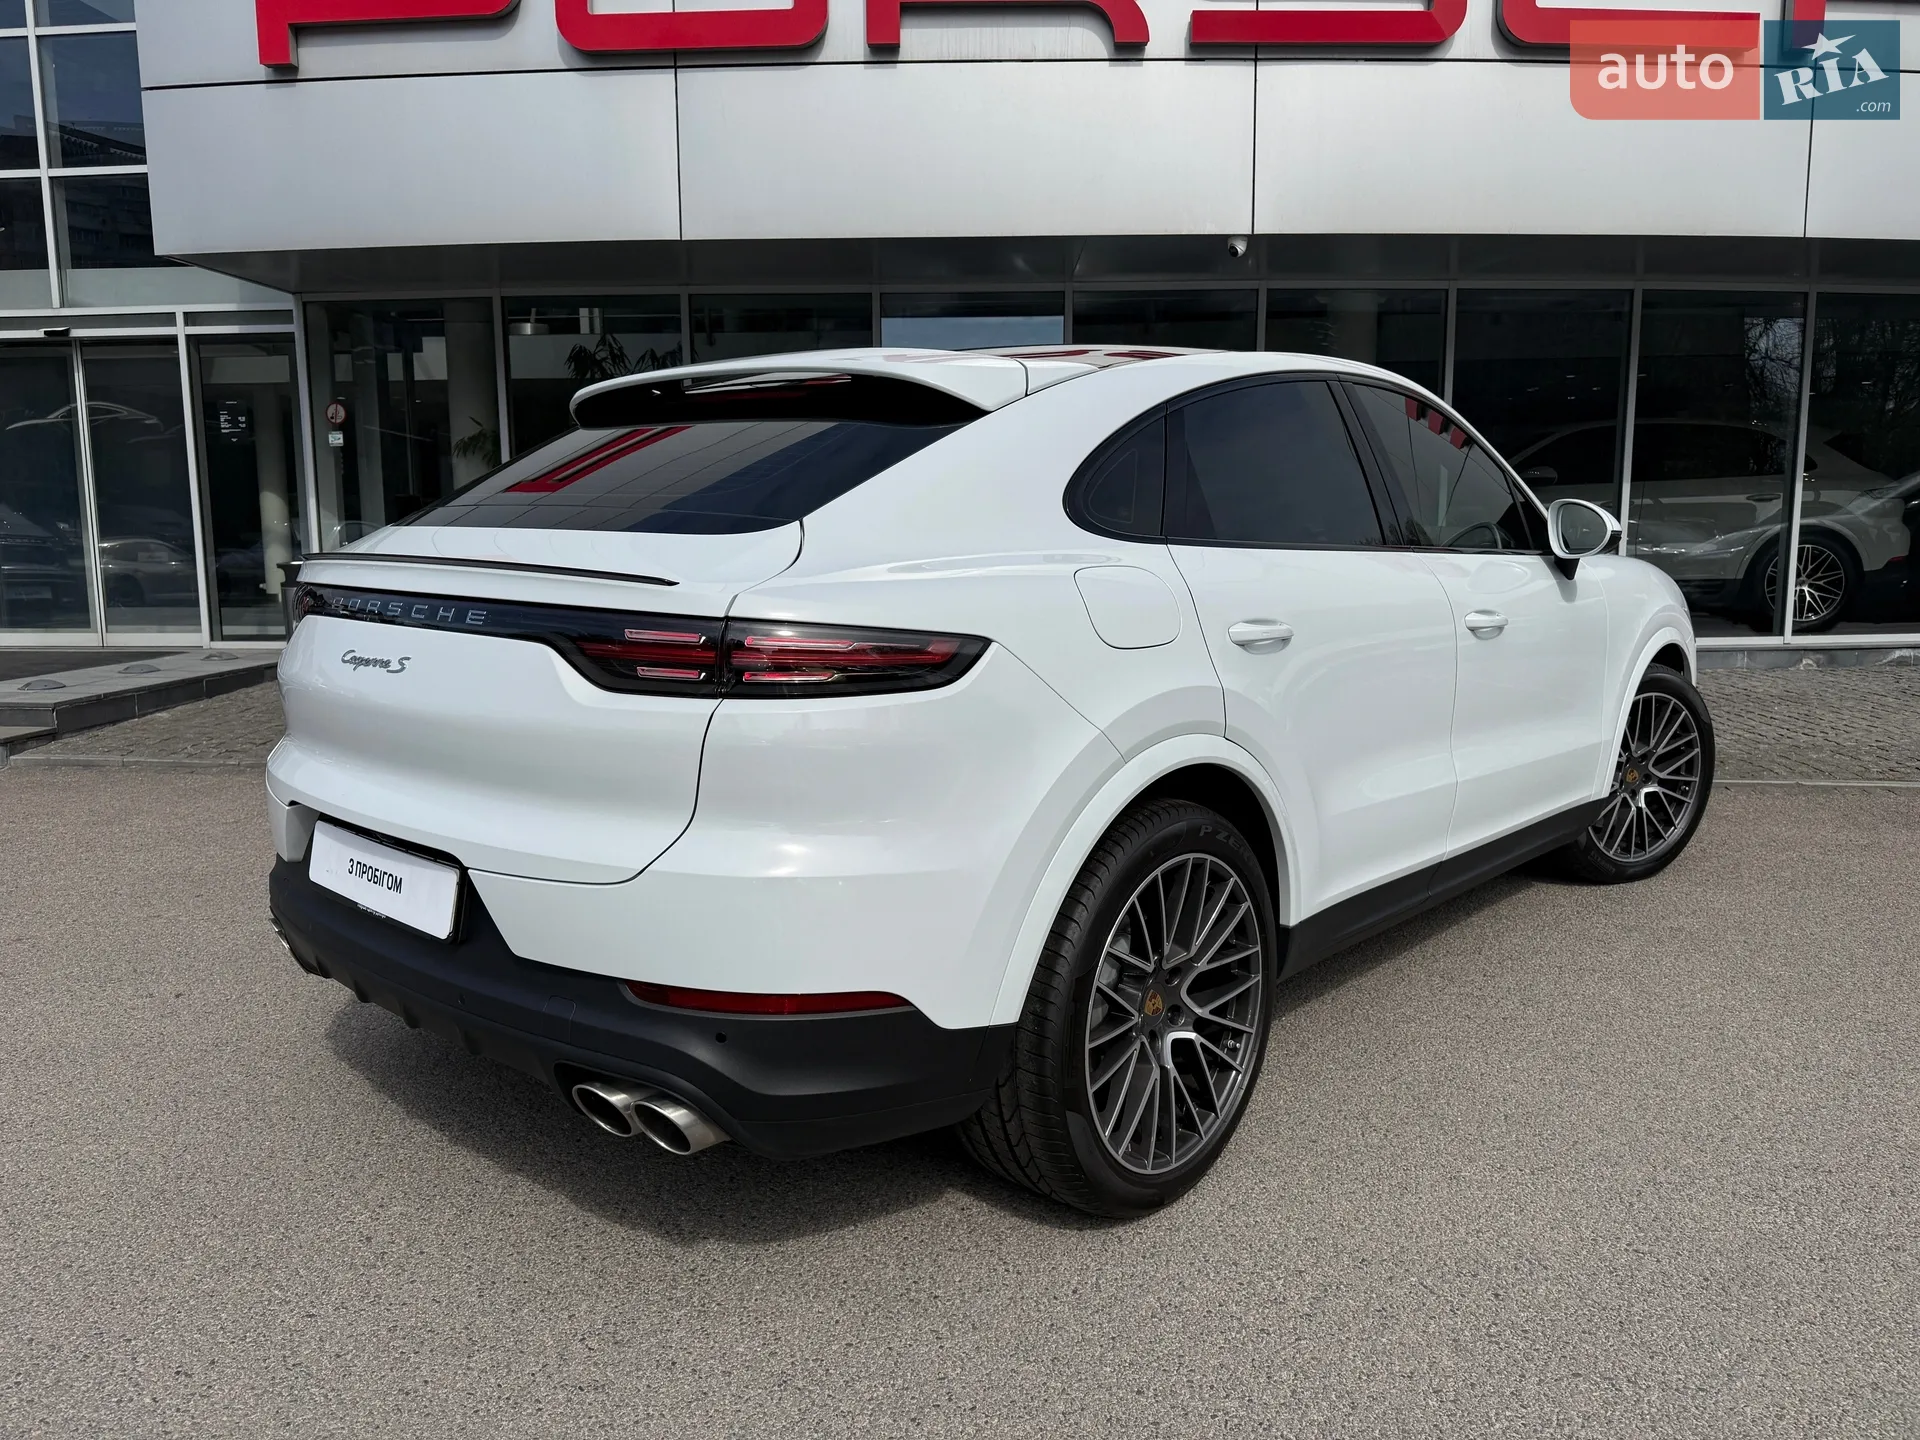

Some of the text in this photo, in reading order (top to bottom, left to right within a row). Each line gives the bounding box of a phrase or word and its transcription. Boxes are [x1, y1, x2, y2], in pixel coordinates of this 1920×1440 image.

[332, 597, 487, 626] PORSCHE
[341, 649, 412, 674] Cayenne S
[354, 860, 403, 894] ПРОБІГОМ
